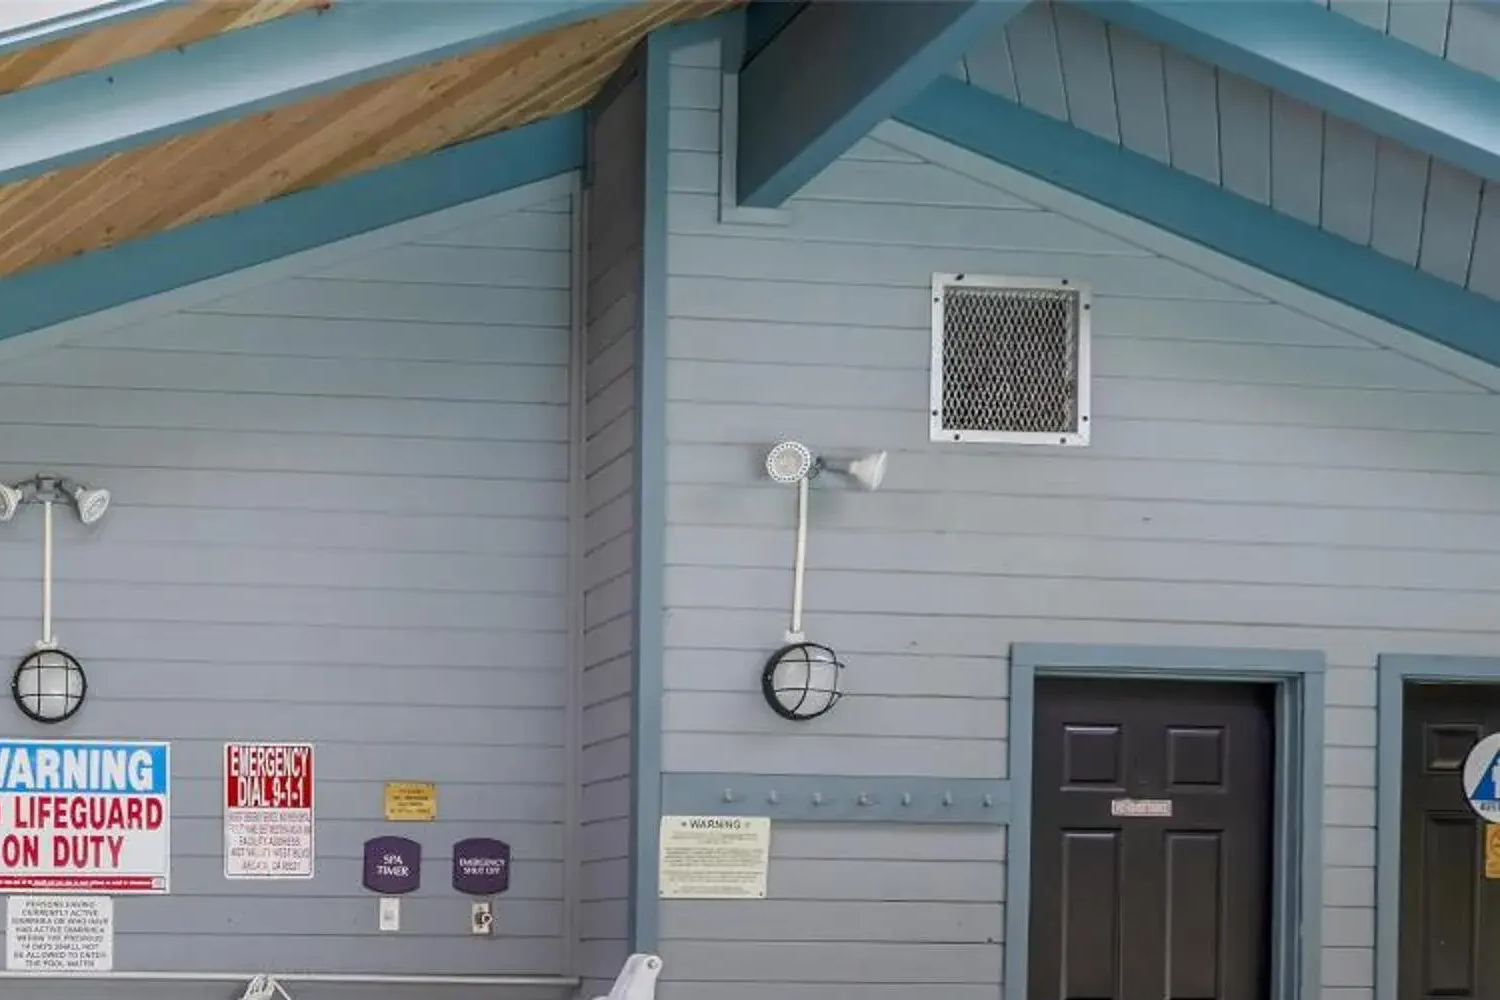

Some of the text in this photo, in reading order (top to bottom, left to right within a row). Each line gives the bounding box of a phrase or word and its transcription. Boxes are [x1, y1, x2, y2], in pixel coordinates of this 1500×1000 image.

[230, 746, 308, 777] EMERGENCY
[237, 777, 304, 807] DIAL 9-1-1
[14, 796, 163, 830] LIFEGUARD
[690, 819, 741, 829] WARNING
[2, 834, 124, 869] ON DUTY
[383, 854, 403, 865] SPA
[376, 865, 409, 877] TIMER
[459, 858, 505, 867] EMERGENCY
